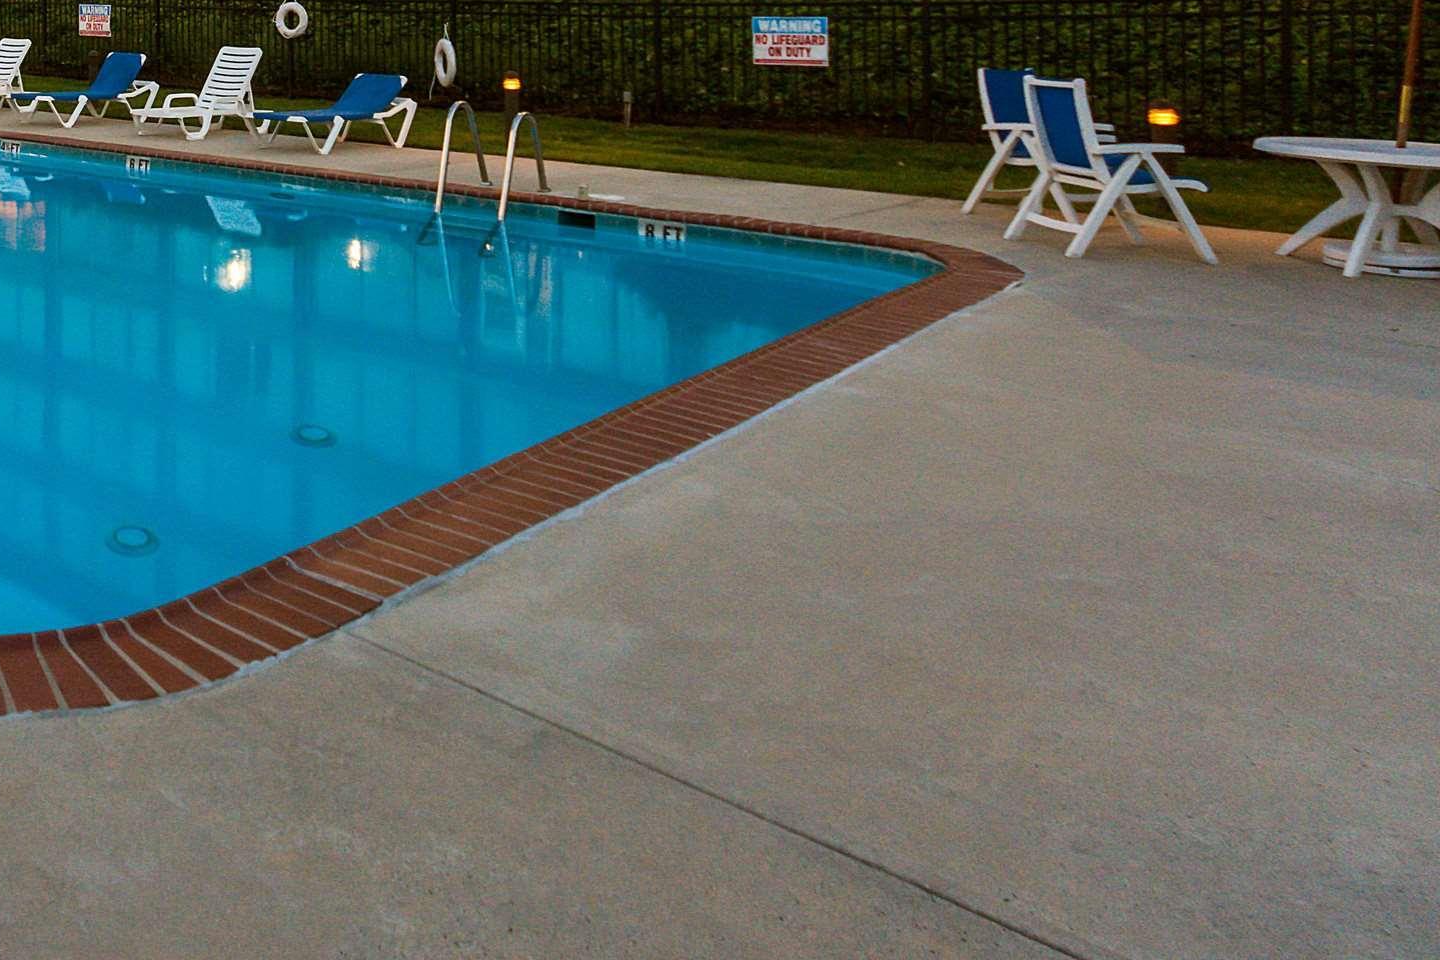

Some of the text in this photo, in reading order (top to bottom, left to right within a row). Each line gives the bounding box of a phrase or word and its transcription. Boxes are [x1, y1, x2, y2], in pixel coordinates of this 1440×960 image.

[81, 5, 109, 16] WARNING
[758, 19, 822, 33] WARNING
[755, 35, 825, 45] NO LIFEGUARD
[768, 47, 811, 57] ON DUTY
[663, 225, 684, 241] FT
